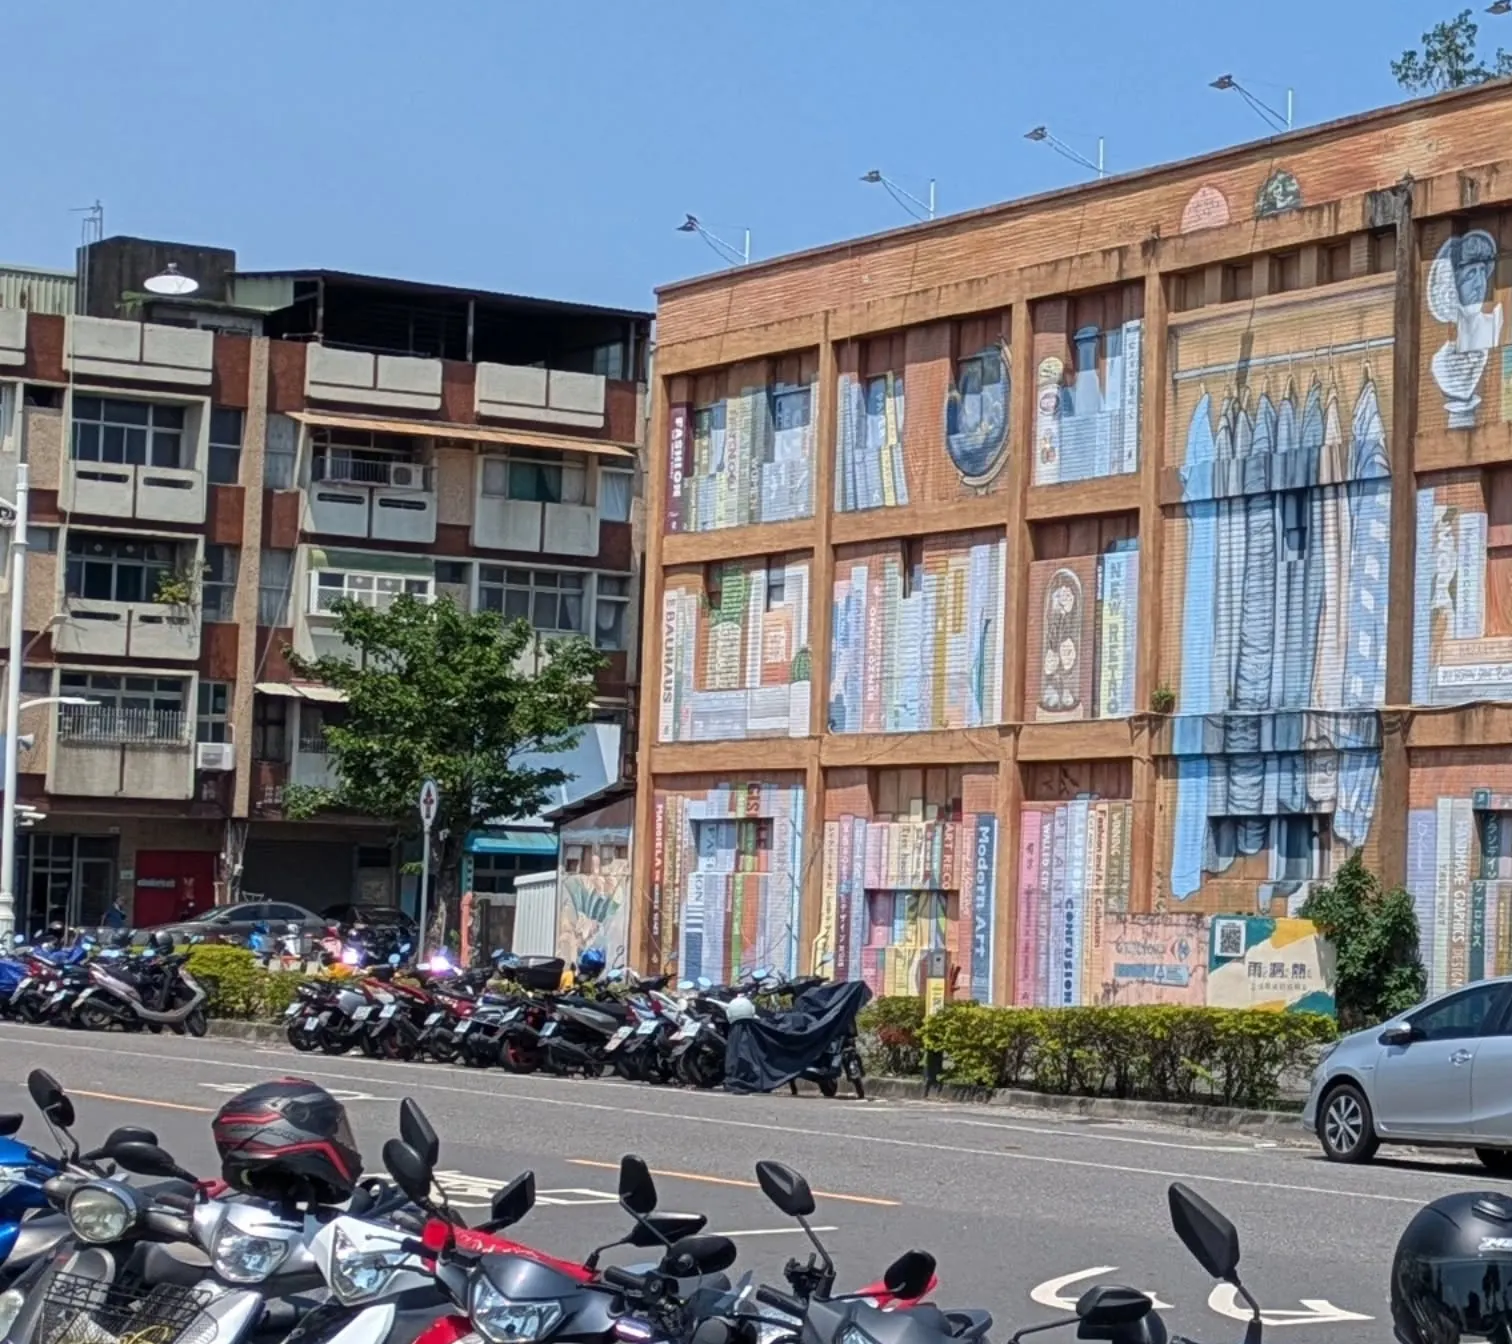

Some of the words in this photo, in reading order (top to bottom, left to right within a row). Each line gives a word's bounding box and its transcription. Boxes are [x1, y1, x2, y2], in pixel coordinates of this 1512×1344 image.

[672, 415, 683, 498] FASHION
[662, 610, 676, 704] BAUHAUS
[944, 823, 955, 850] ART
[976, 825, 991, 908] Modern
[975, 914, 988, 959] Art
[1063, 897, 1074, 1003] CONFUSION
